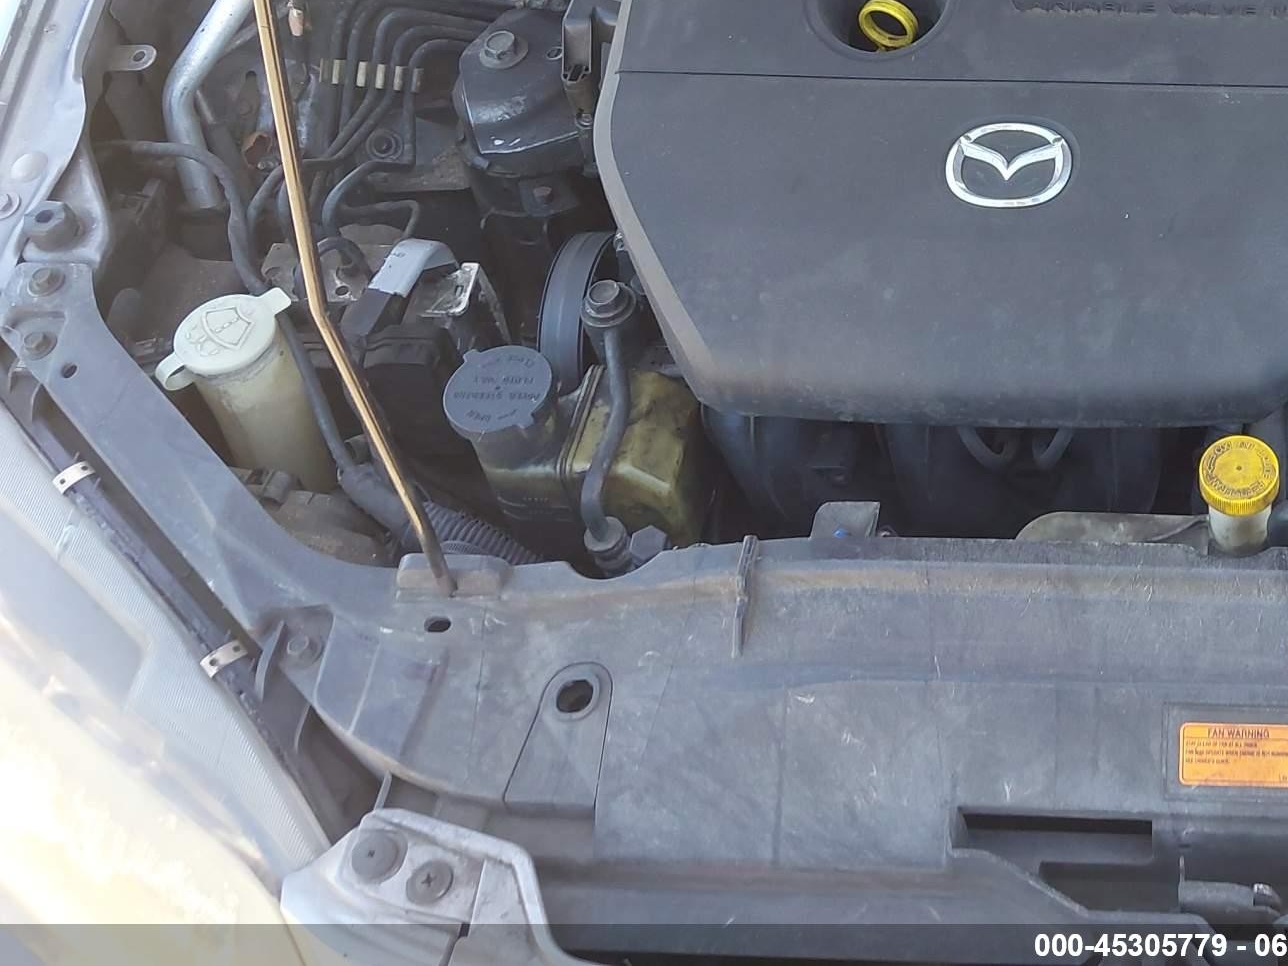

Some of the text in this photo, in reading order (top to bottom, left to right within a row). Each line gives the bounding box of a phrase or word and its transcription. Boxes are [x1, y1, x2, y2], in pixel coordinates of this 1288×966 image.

[1168, 1, 1258, 18] VALVE
[1207, 728, 1270, 740] FAN WARNING
